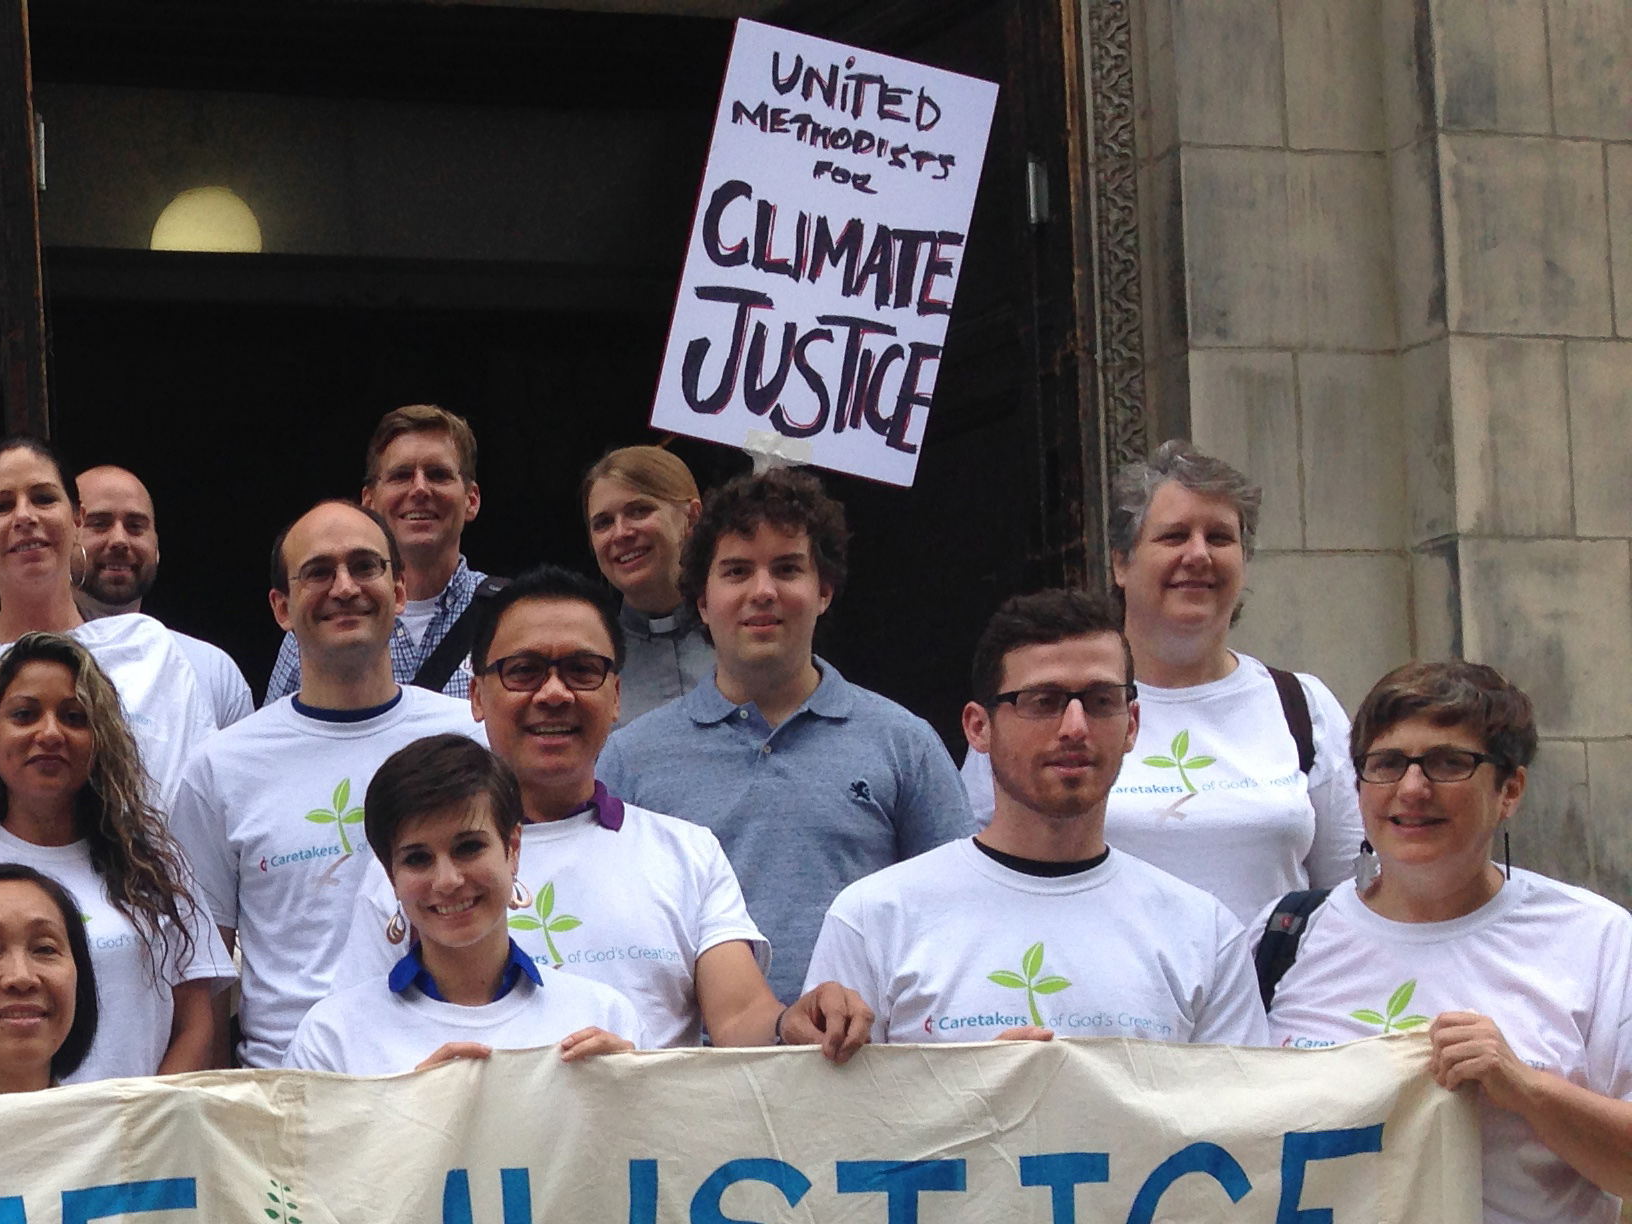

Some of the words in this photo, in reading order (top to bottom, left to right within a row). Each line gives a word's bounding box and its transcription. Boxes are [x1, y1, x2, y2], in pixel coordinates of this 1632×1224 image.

[731, 100, 956, 180] METHODISTS
[812, 160, 878, 194] FOR
[702, 179, 965, 316] CLIMATE
[681, 285, 945, 455] JUSTICE
[1202, 781, 1215, 792] of
[1219, 777, 1258, 792] God's
[270, 845, 341, 868] Caretakers
[568, 950, 582, 963] of
[585, 947, 623, 963] God's
[627, 945, 680, 961] Creation
[939, 1012, 1027, 1031] Caretakers
[1049, 1014, 1065, 1027] of
[1068, 1012, 1113, 1028] God's
